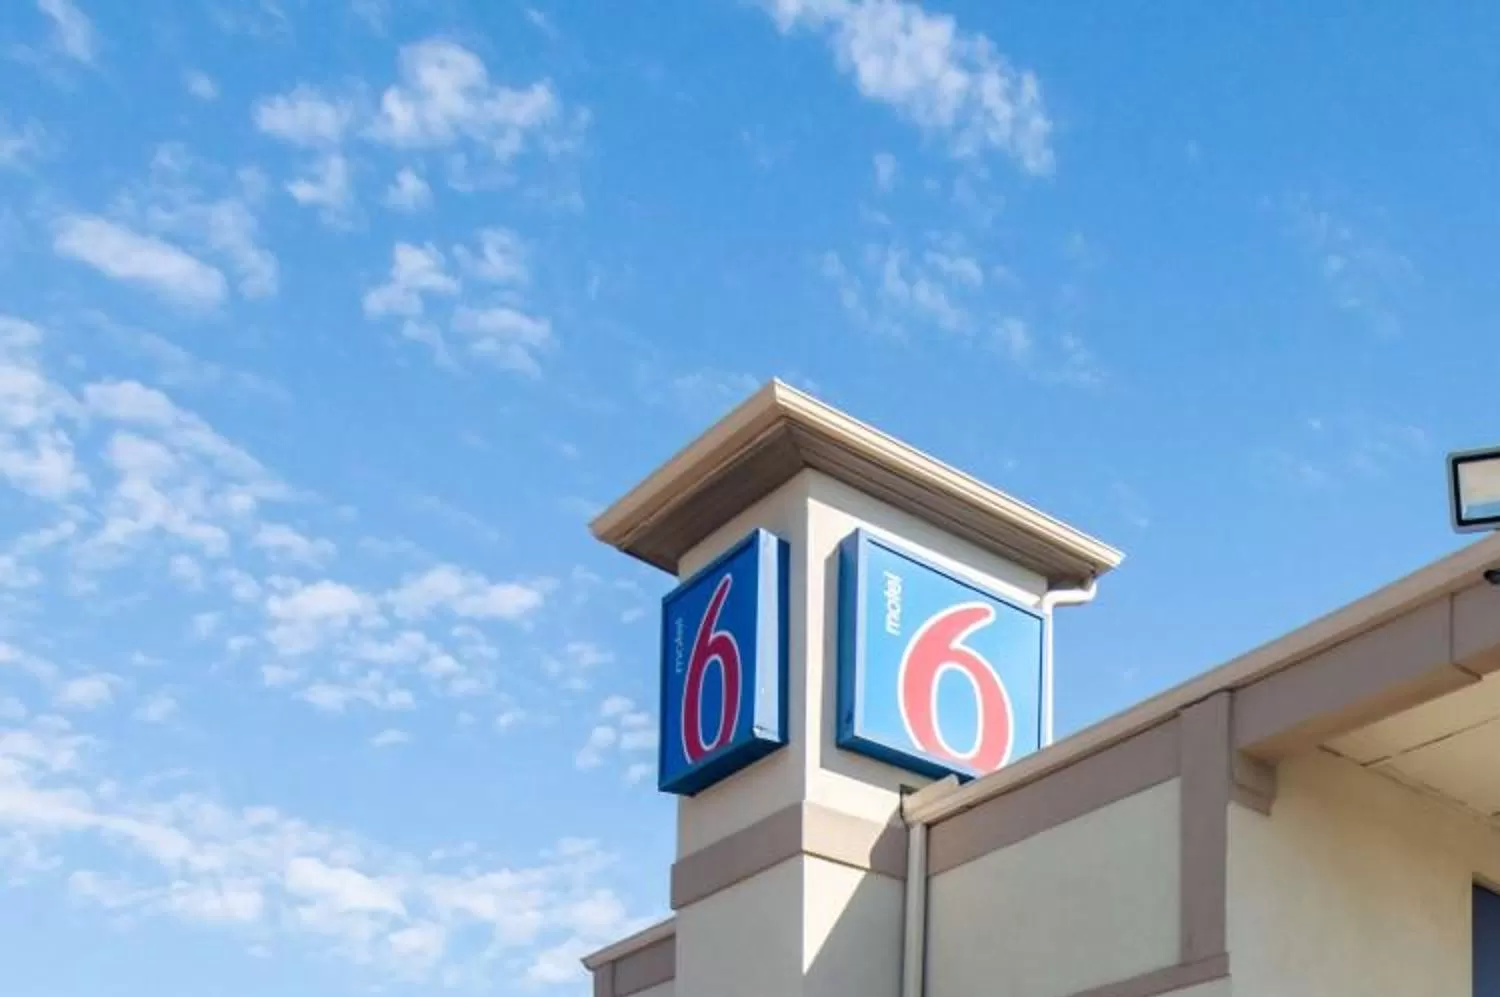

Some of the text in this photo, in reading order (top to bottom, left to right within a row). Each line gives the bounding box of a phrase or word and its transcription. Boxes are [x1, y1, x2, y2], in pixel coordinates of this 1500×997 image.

[681, 573, 742, 765] 6
[883, 571, 902, 637] motel
[897, 601, 1014, 776] 6
